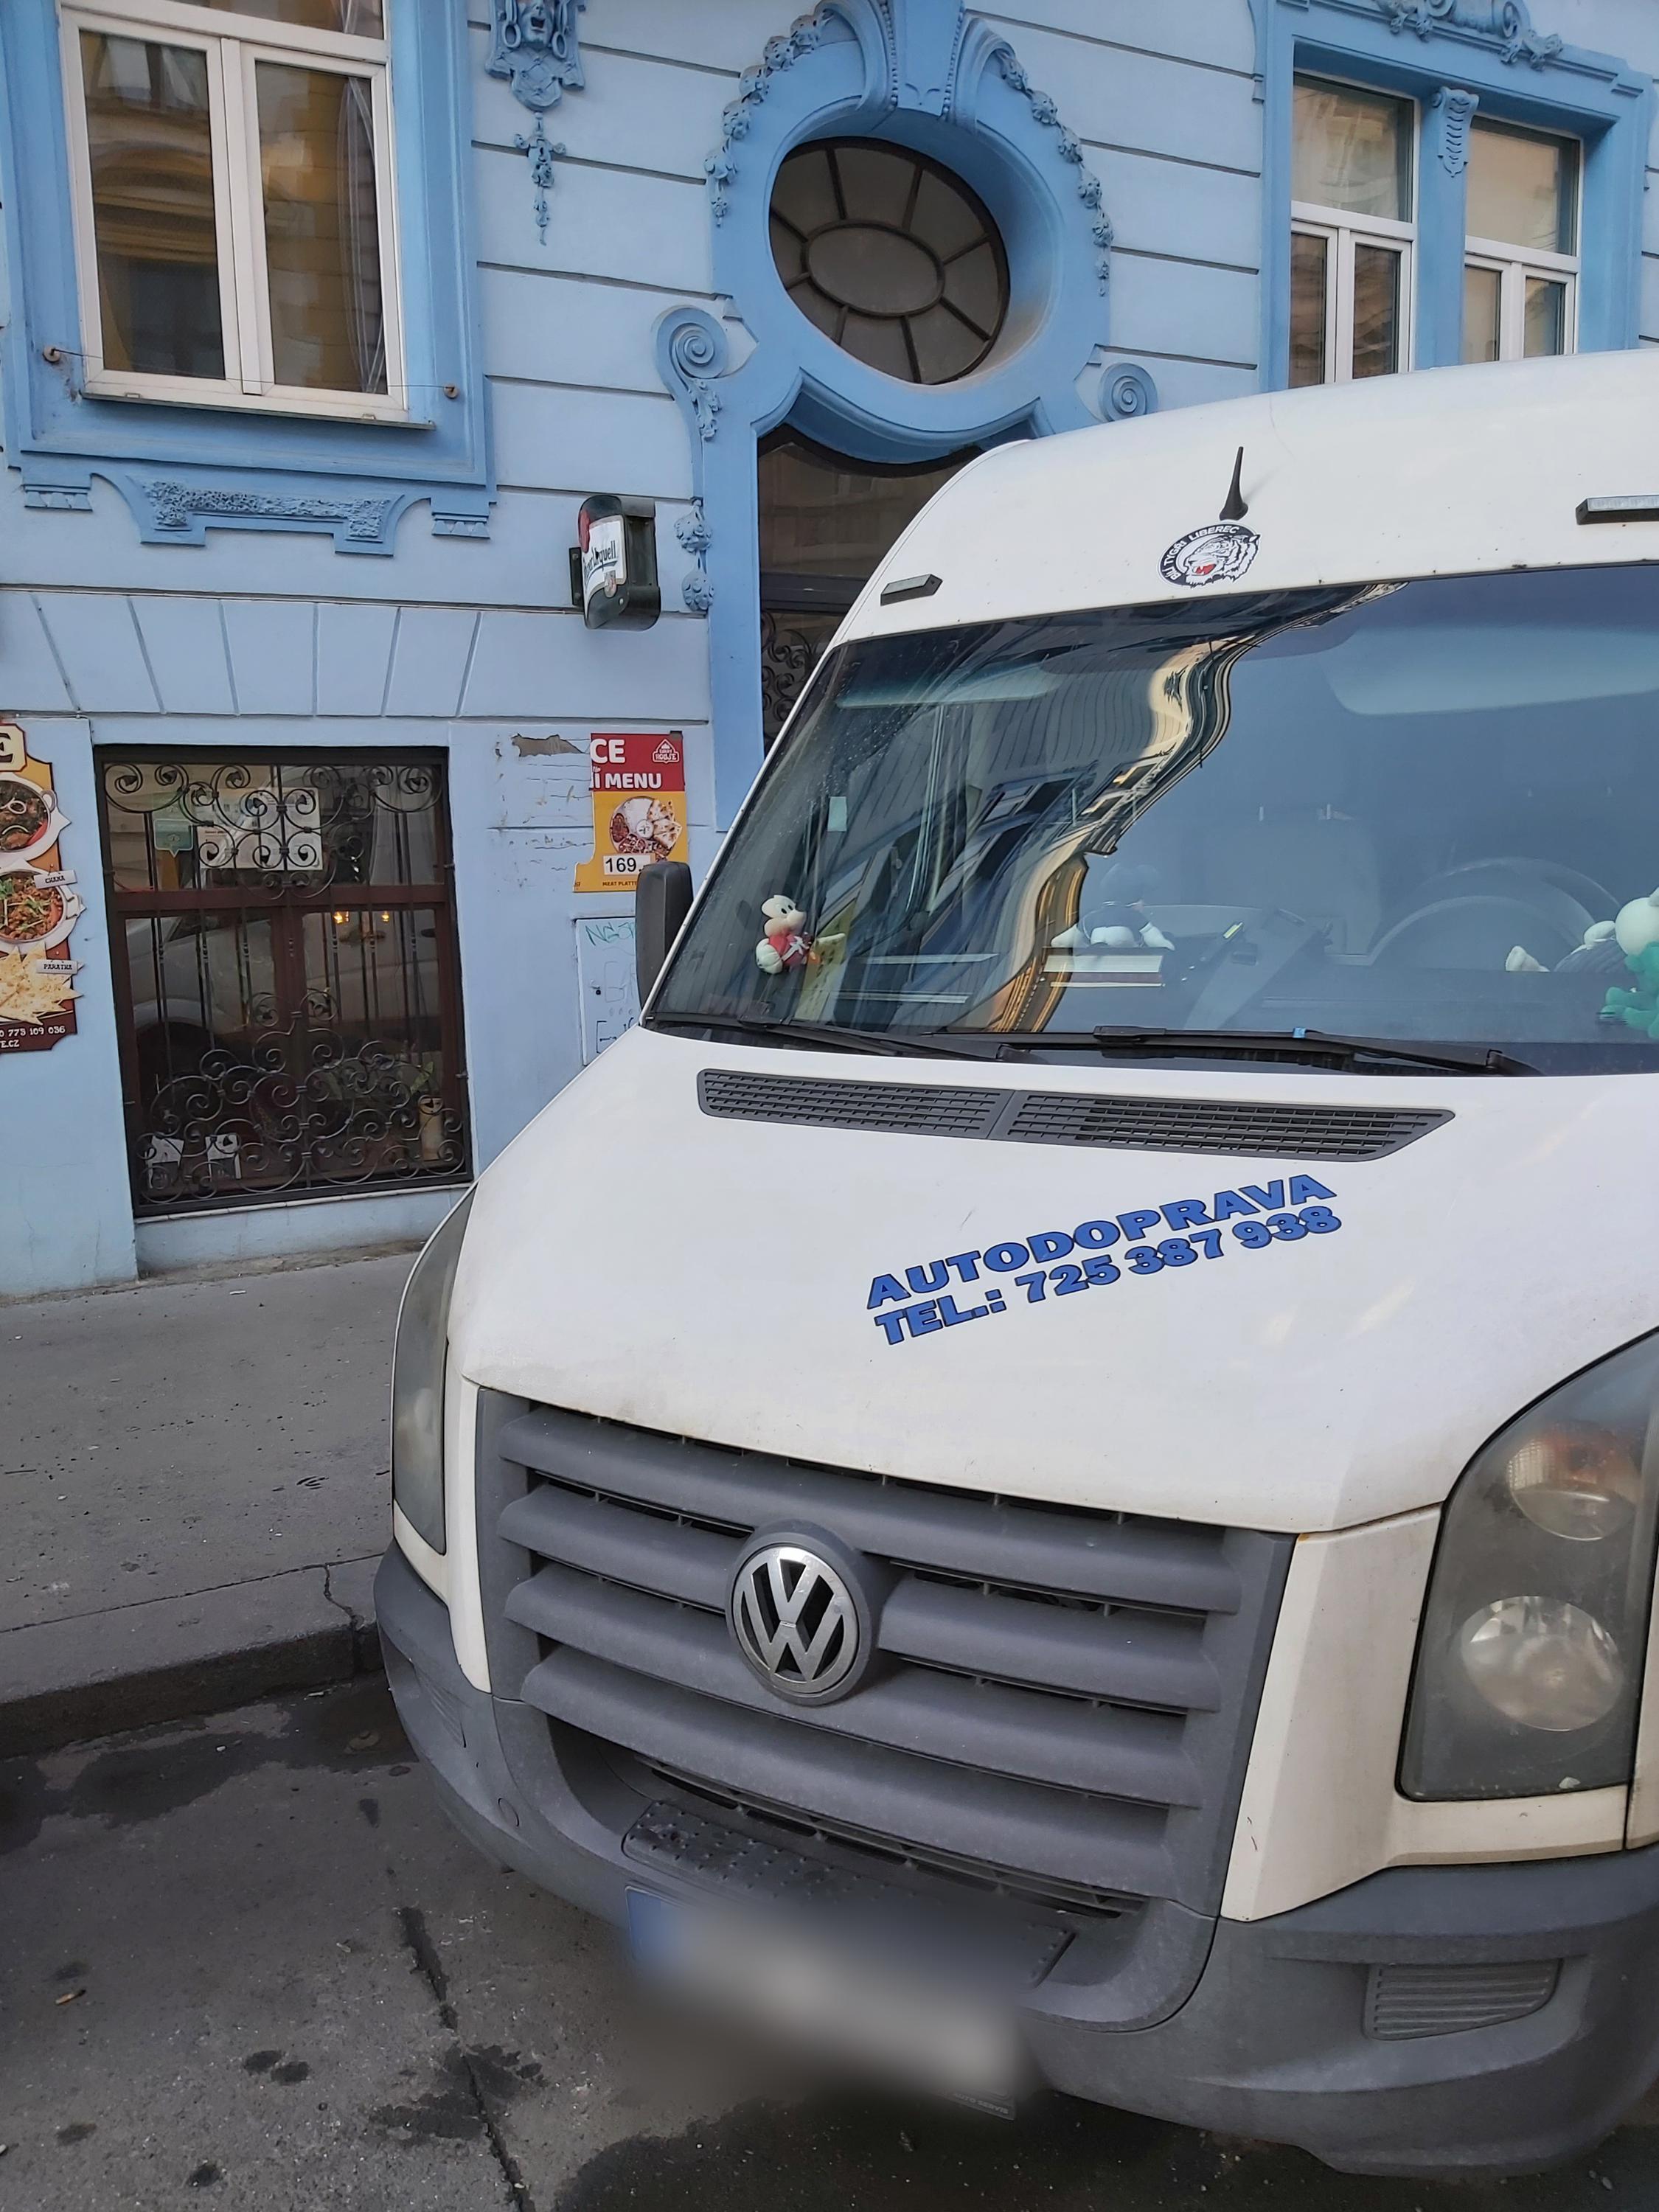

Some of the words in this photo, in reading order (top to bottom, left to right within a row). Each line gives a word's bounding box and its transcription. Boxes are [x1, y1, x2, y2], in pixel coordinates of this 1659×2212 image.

[1188, 525, 1240, 541] LIBEREC
[605, 773, 662, 789] MENU
[29, 1026, 45, 1035] 109
[867, 1174, 1338, 1310] AUTODOPRAVA
[874, 1288, 1007, 1346] TEL.:
[1014, 1254, 1121, 1304] 725
[1124, 1228, 1225, 1275] 387
[1231, 1205, 1342, 1249] 938
